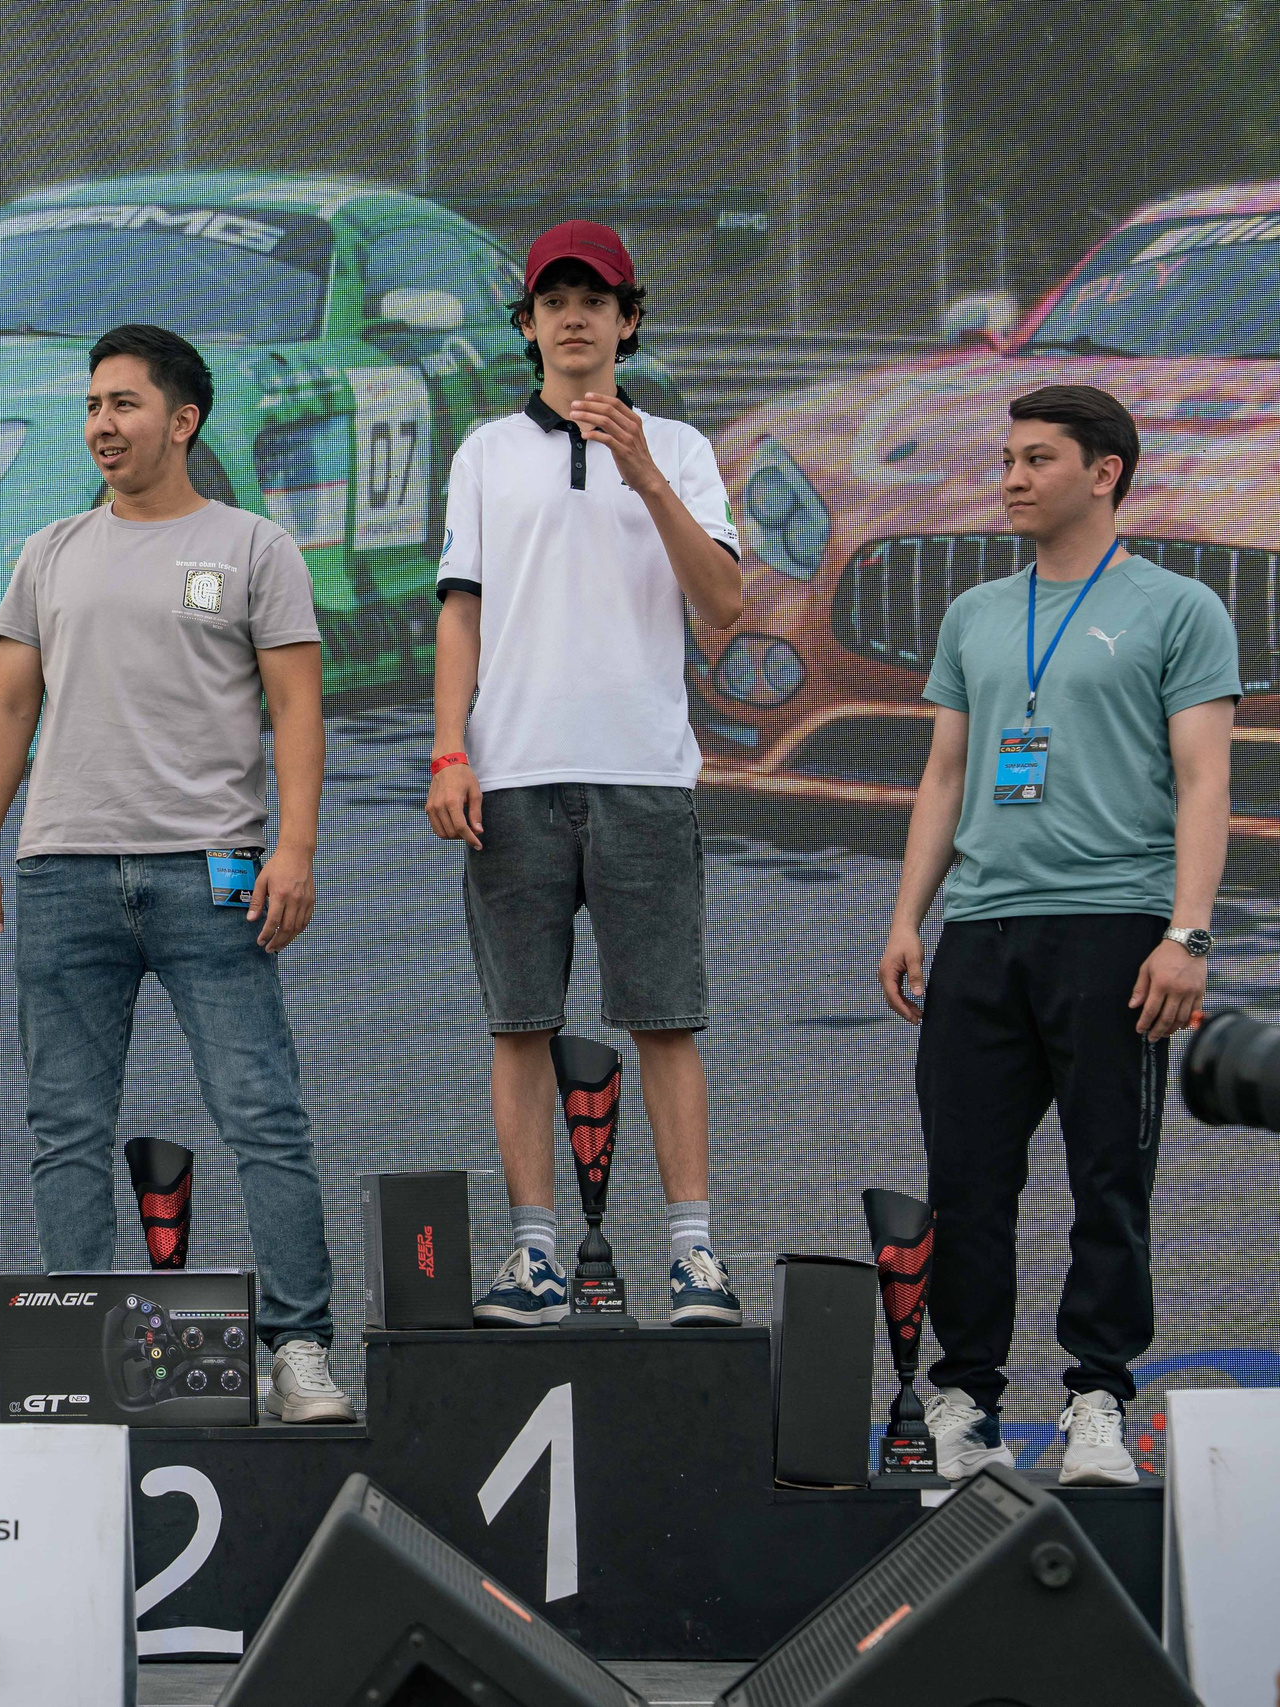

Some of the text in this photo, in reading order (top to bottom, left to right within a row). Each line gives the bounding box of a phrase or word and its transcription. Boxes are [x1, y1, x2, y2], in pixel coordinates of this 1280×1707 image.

[369, 419, 418, 509] 07
[417, 1233, 426, 1270] KEEP
[424, 1225, 435, 1278] RACING
[9, 1292, 98, 1307] SIMAGIC
[23, 1394, 68, 1413] GT
[477, 1382, 578, 1603] 1
[136, 1465, 244, 1656] 2
